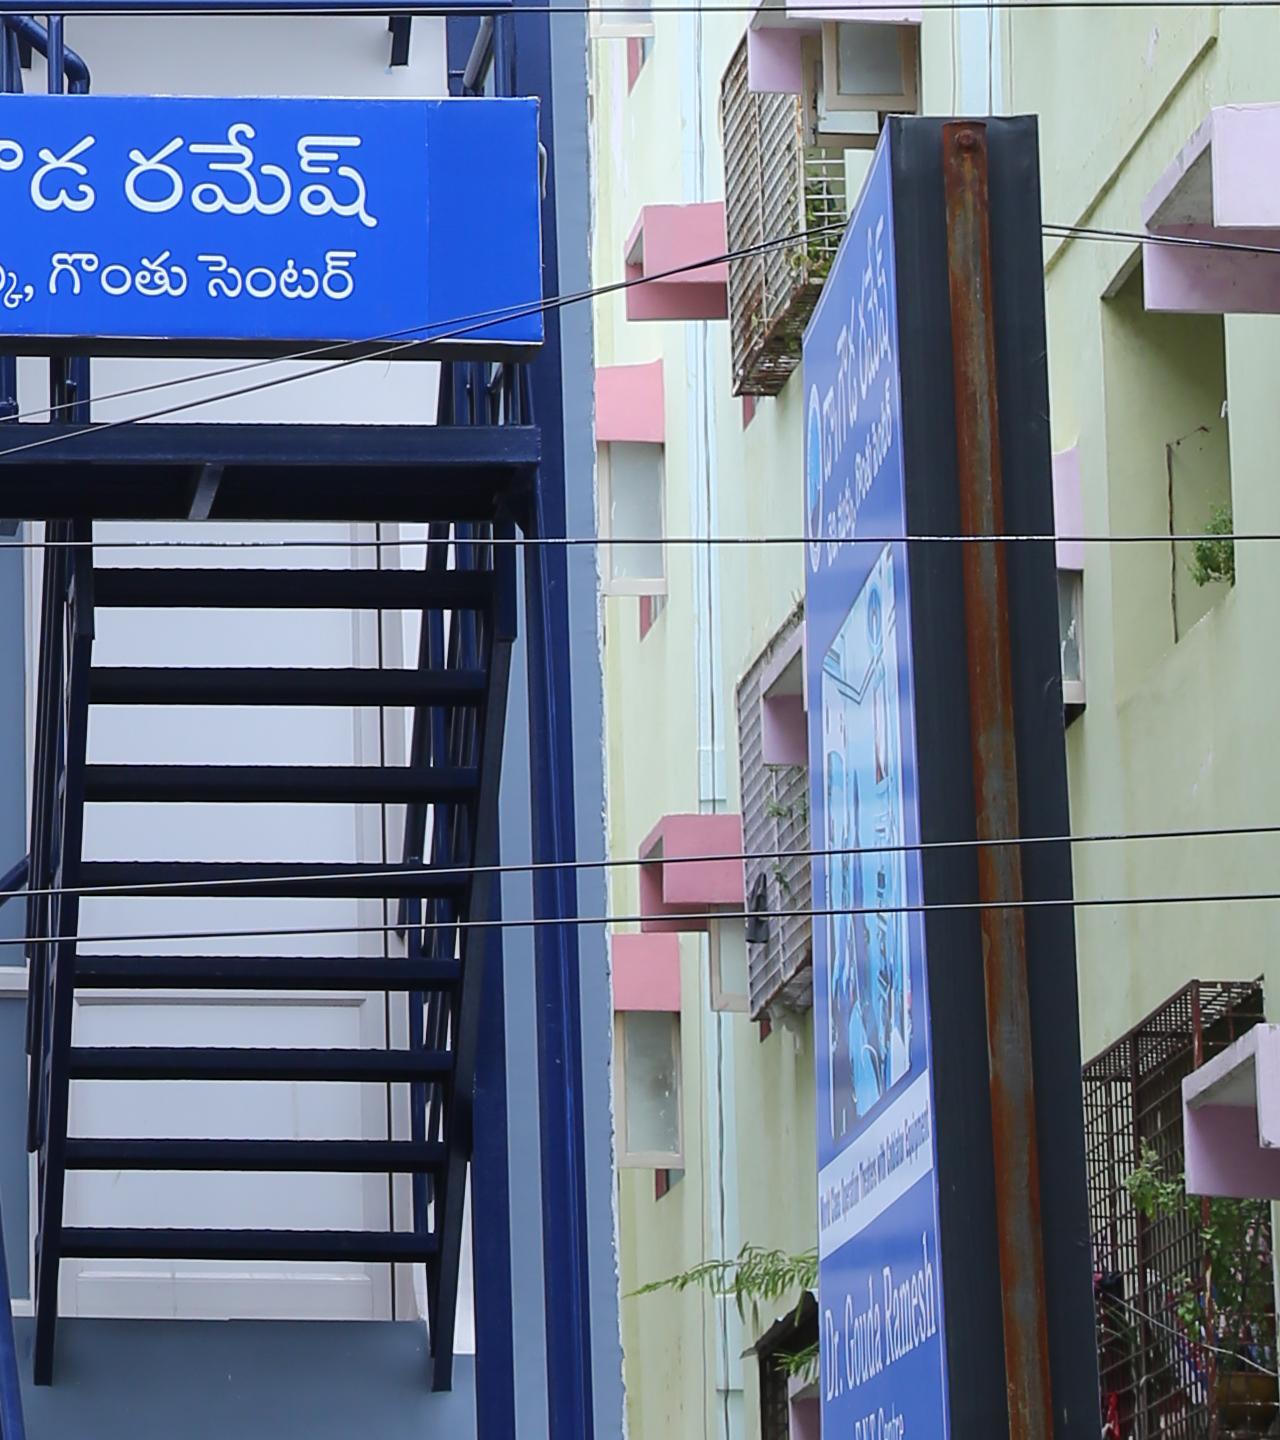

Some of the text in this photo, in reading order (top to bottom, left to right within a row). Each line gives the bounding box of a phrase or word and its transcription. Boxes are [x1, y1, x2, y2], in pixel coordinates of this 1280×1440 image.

[124, 122, 379, 228] రమేష్
[48, 251, 188, 297] గొంతు
[197, 251, 358, 300] సెంటర్
[825, 1231, 938, 1402] Dr. Gouda Ramesh
